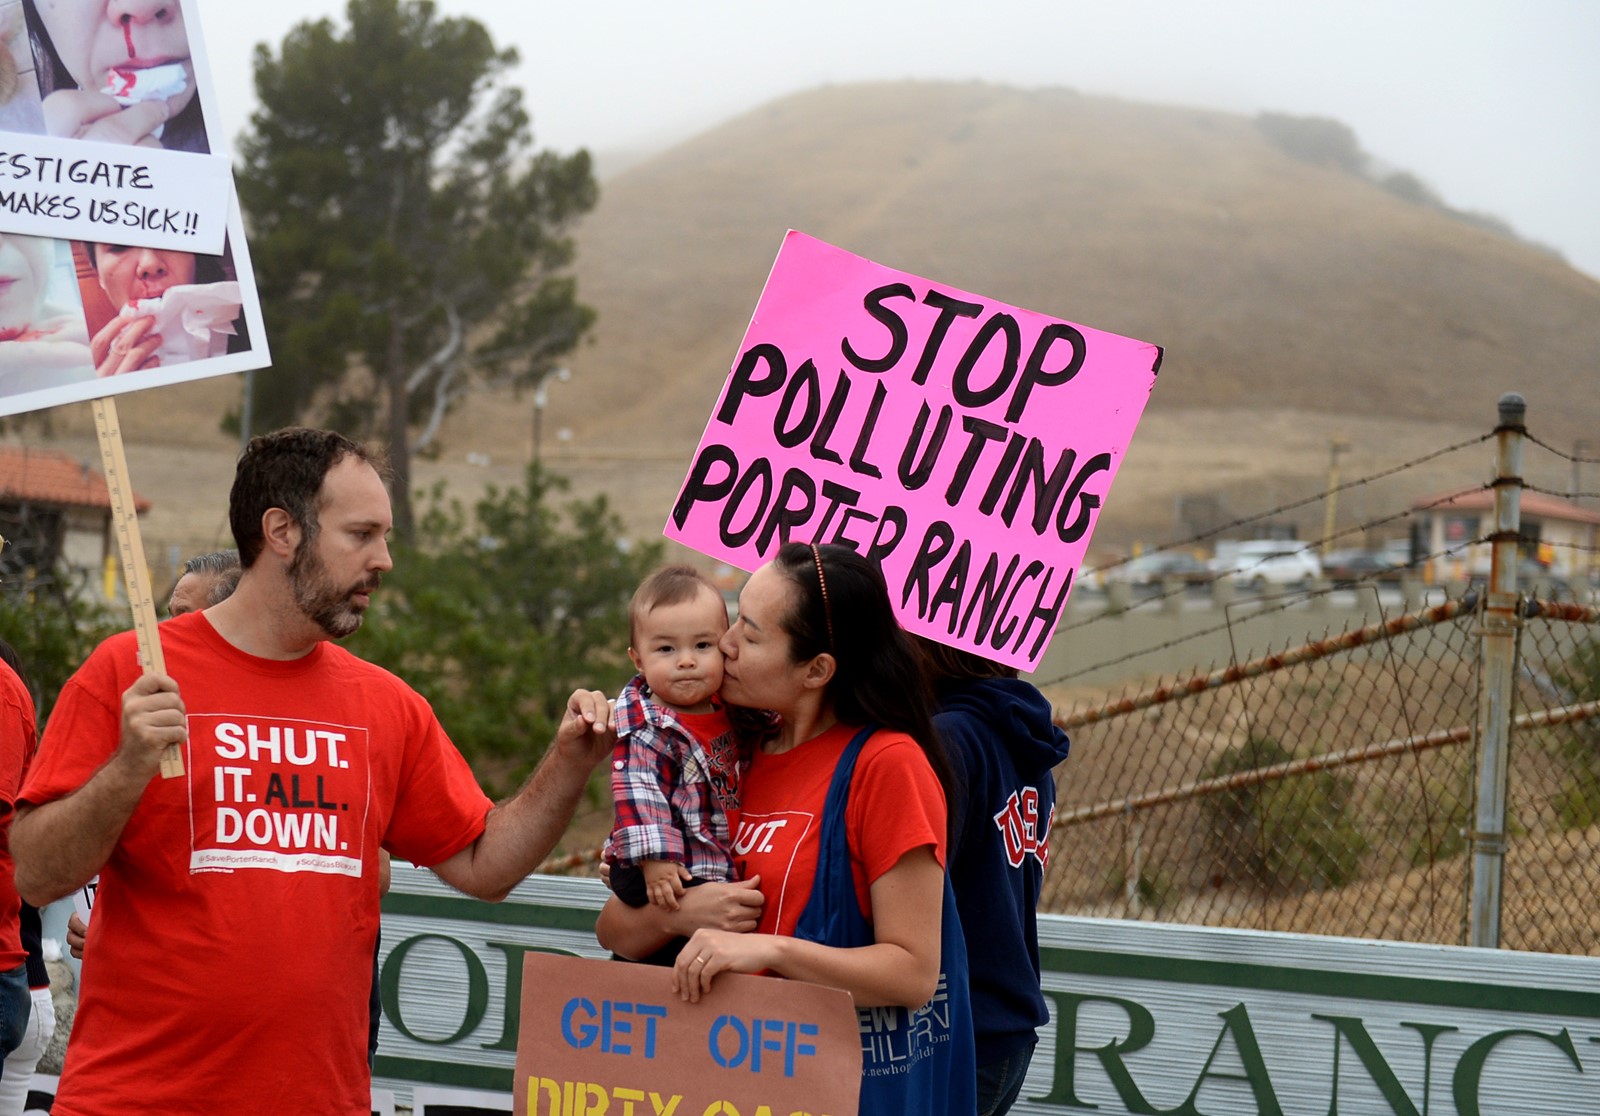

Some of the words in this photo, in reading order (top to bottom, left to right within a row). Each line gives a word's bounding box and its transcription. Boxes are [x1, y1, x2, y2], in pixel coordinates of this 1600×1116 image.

[841, 282, 1086, 424] STOP
[717, 343, 1111, 543] POLLUTING
[902, 521, 1074, 662] RANCH
[214, 722, 349, 769] SHUT.
[214, 766, 257, 803] IT.
[265, 772, 349, 811] ALL.
[215, 806, 348, 851] DOWN.
[198, 853, 279, 865] @SavePorterRanch
[560, 996, 668, 1060] GET
[708, 1014, 819, 1078] OFF
[1027, 989, 1600, 1116] RANC
